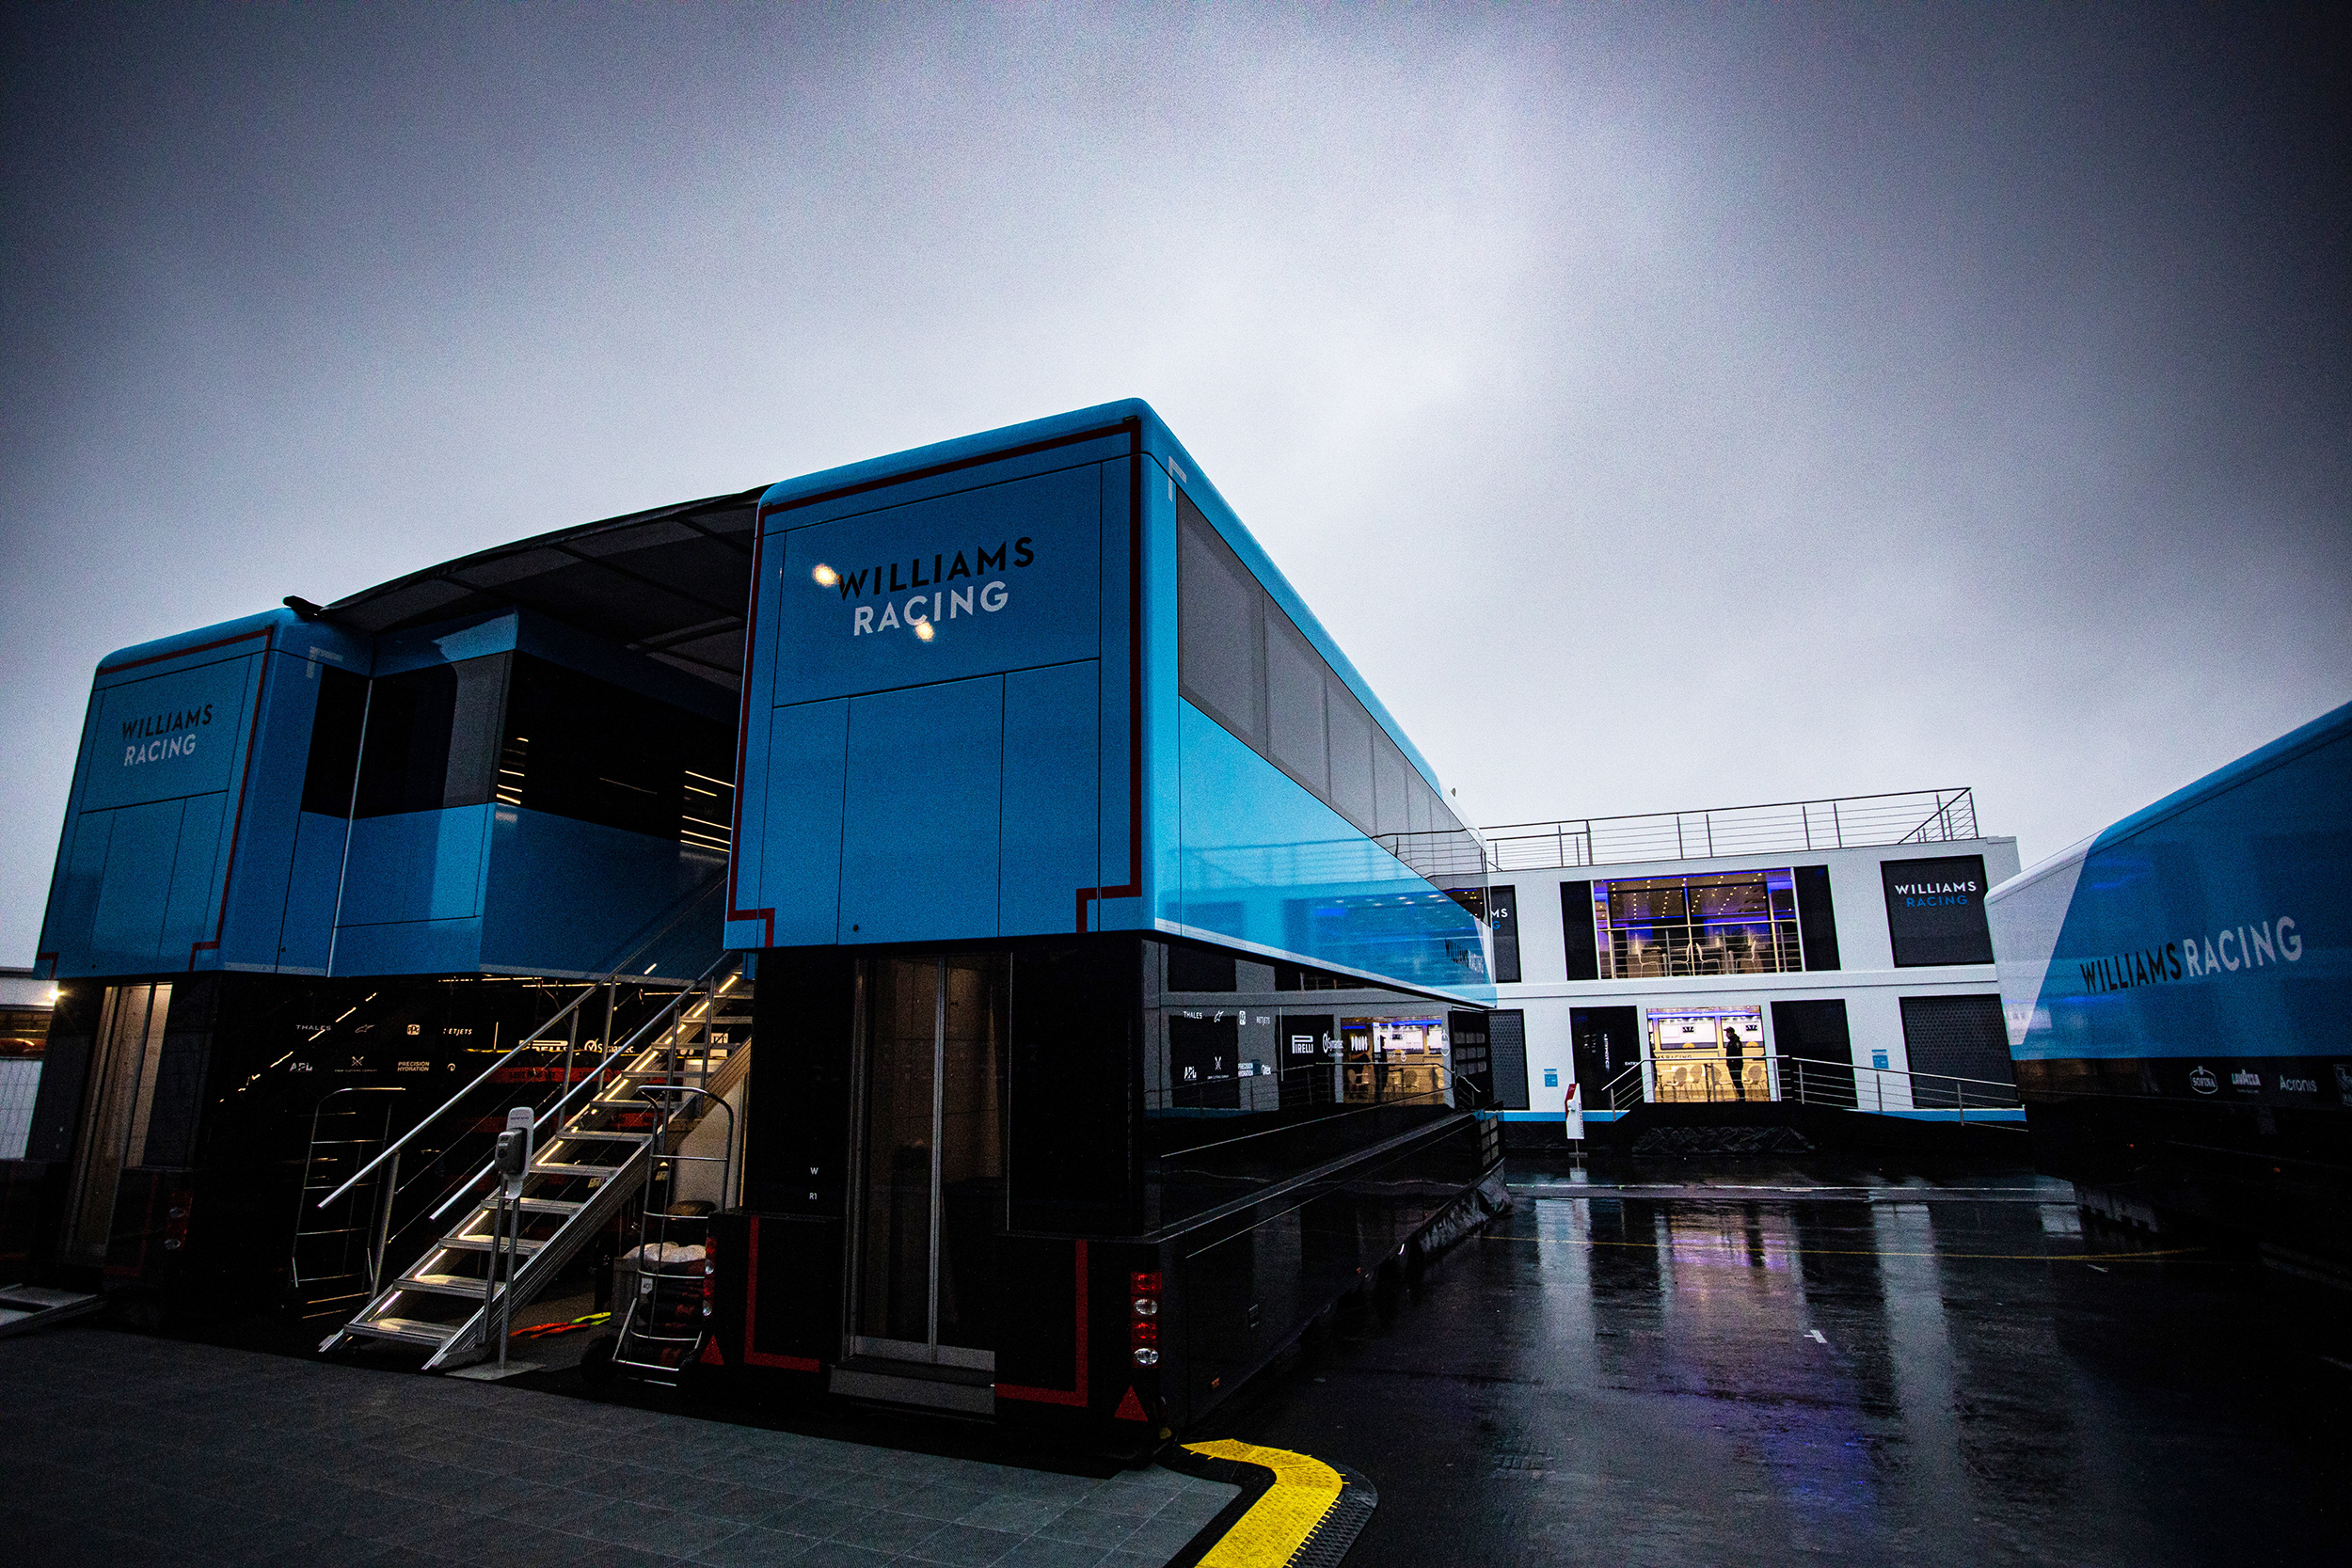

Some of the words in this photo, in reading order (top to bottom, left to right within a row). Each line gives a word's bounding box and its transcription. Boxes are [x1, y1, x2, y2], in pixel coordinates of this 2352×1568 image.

[836, 536, 1035, 602] WILLIAMS
[853, 580, 1009, 637] RACING
[122, 704, 213, 741] WILLIAMS
[123, 734, 196, 767] RACING
[1894, 880, 1977, 895] WILLIAMS
[1906, 895, 1968, 908] RACING
[2079, 942, 2182, 994] WILLIAMS
[2183, 915, 2303, 977] RACING
[1184, 1010, 1203, 1020] THALES
[295, 1023, 332, 1032] THALES
[1292, 1035, 1314, 1054] PIRELLI
[2280, 1074, 2317, 1092] Acronis
[810, 1166, 818, 1175] W
